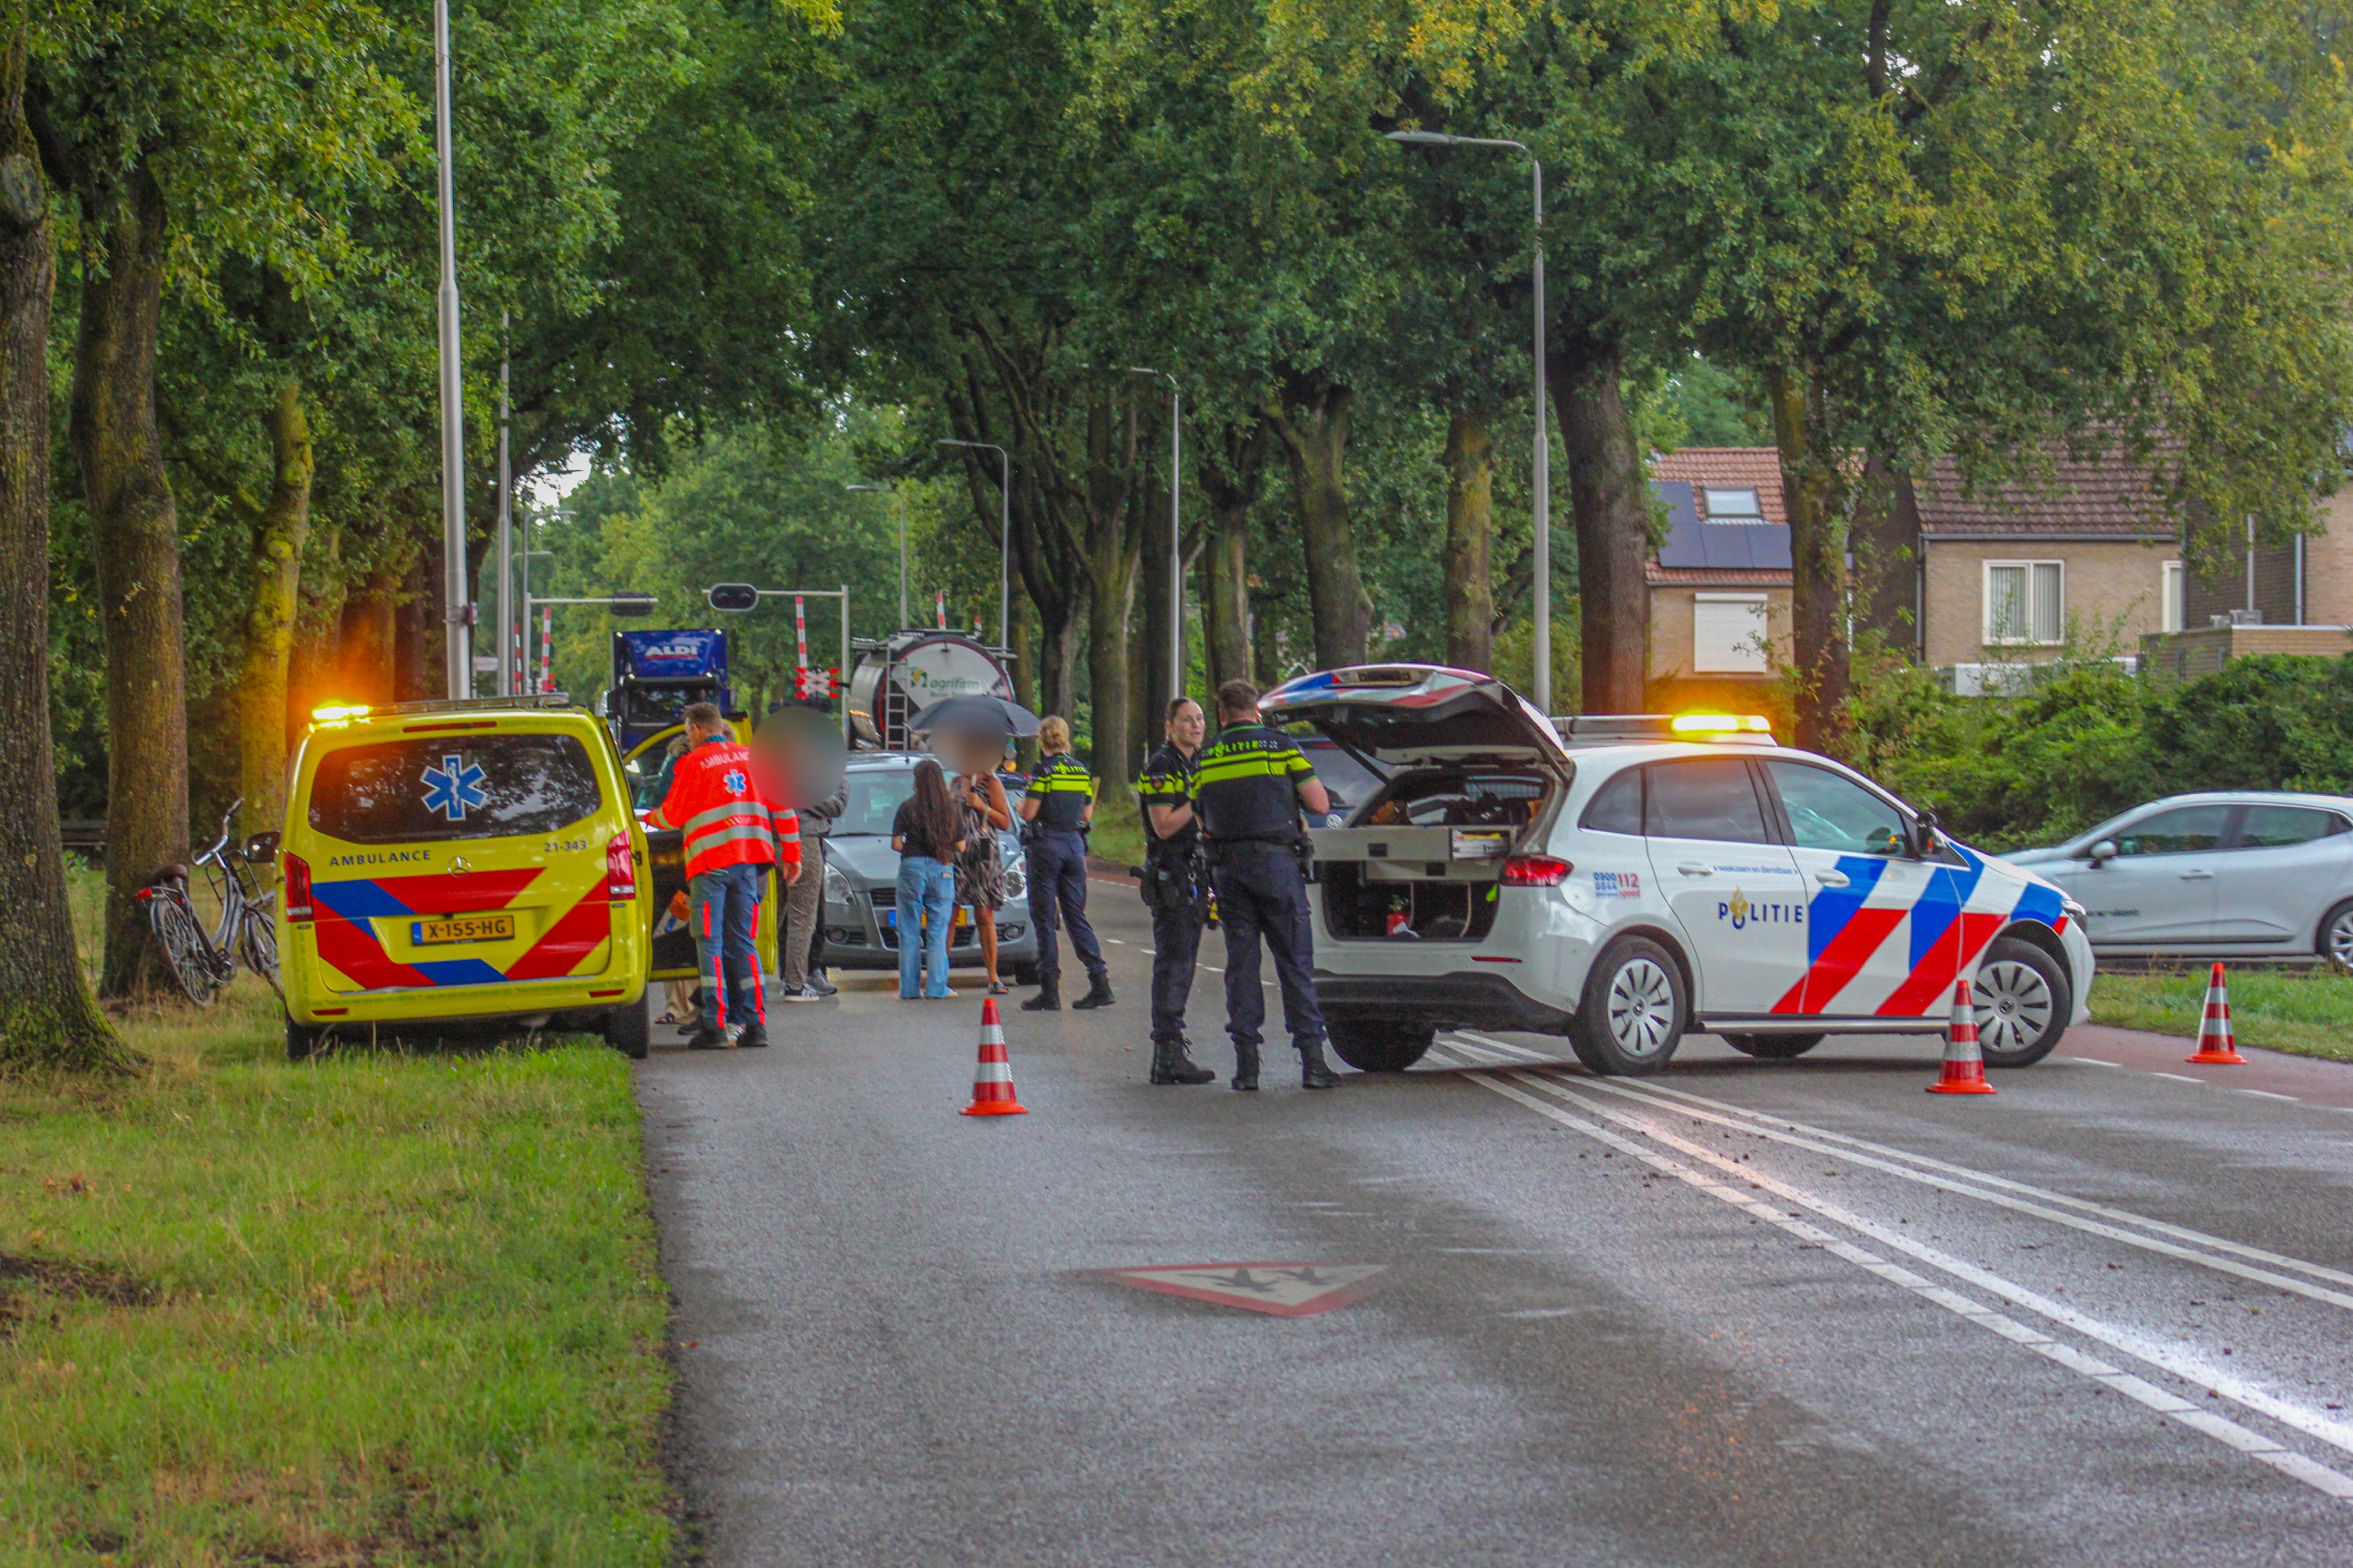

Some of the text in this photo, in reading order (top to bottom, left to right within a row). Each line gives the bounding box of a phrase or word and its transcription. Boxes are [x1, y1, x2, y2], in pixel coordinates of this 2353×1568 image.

[645, 645, 697, 656] ALDI
[930, 677, 979, 691] agrifirm
[544, 840, 588, 852] 21-343
[330, 850, 431, 867] AMBULANCE
[1595, 882, 1617, 890] 8844
[1617, 873, 1639, 887] 112
[1718, 898, 1803, 930] POLITIE
[429, 920, 506, 938] X-155-HG
